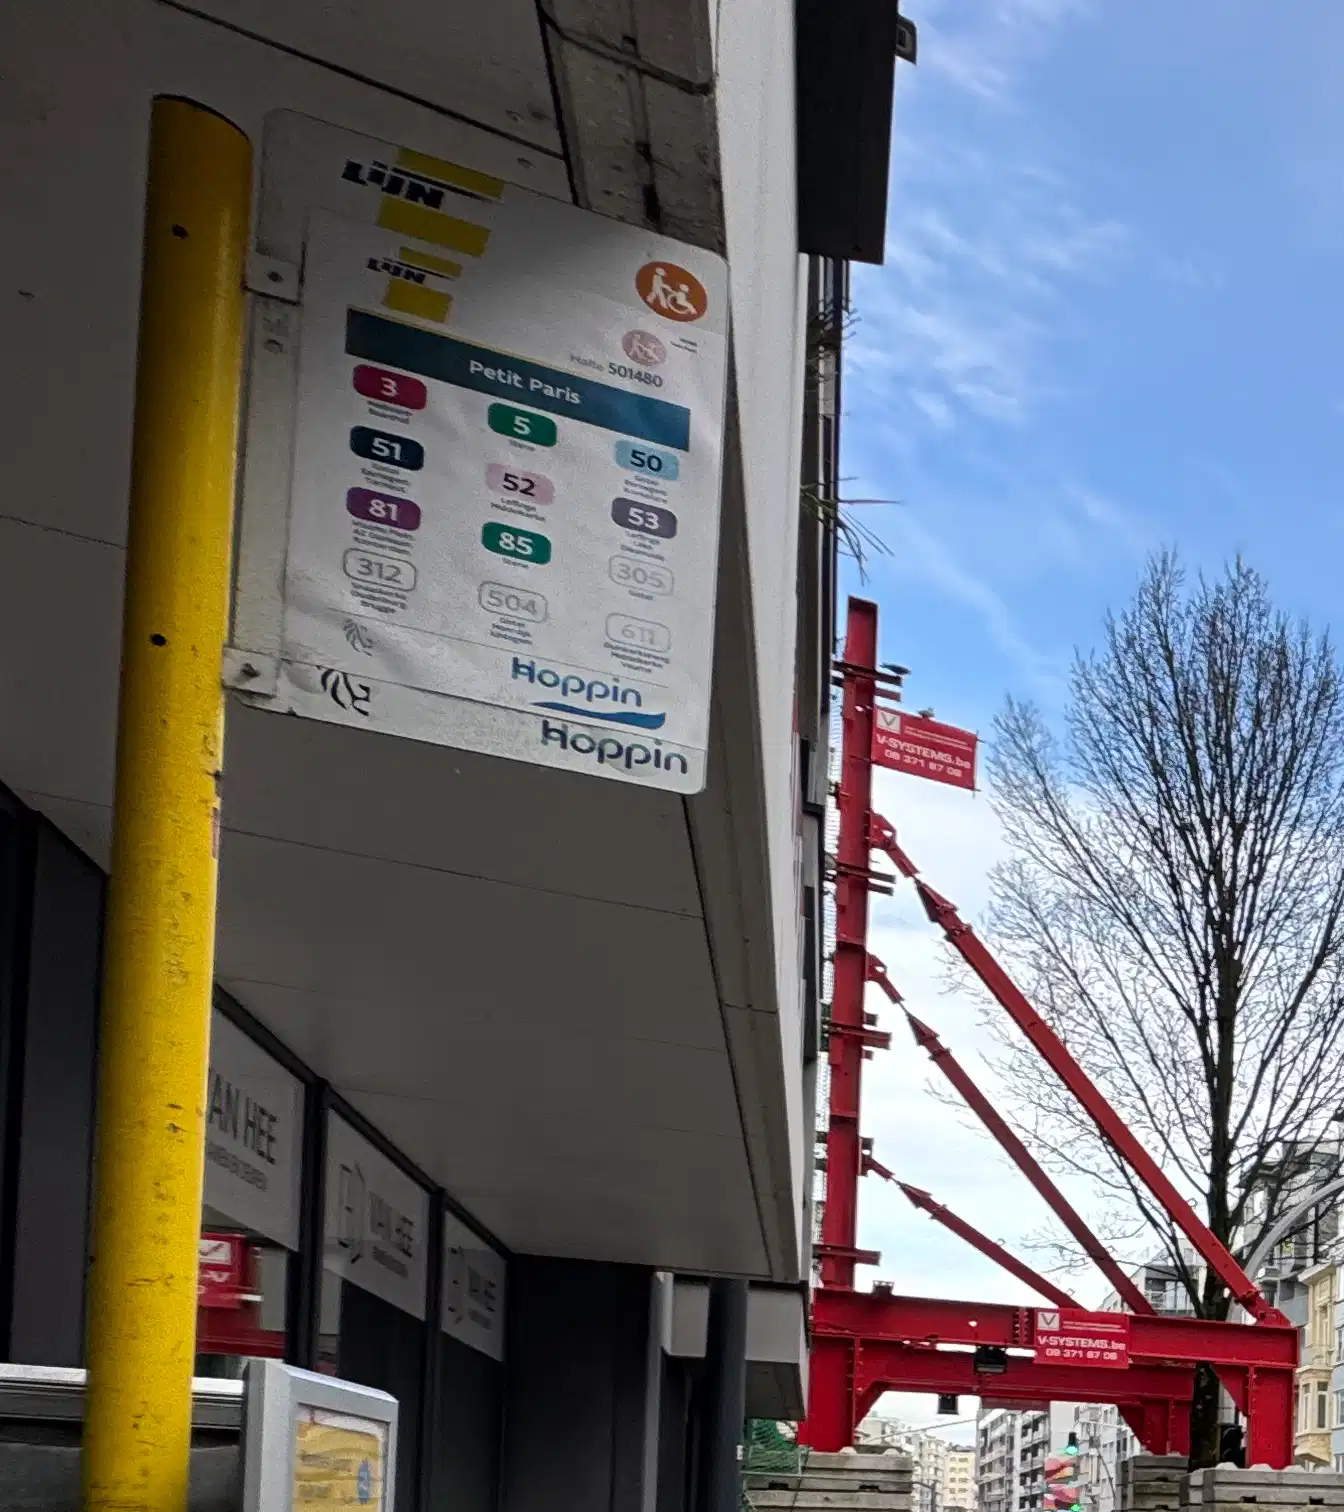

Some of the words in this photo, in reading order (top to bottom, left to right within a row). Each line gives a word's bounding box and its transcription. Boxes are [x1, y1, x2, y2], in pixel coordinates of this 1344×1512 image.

[380, 376, 399, 397] 3
[469, 359, 524, 390] Petit
[529, 377, 581, 404] Paris
[608, 362, 664, 388] 501480
[512, 415, 532, 435] 5
[371, 437, 402, 461] 51
[630, 449, 663, 472] 50
[502, 472, 536, 497] 52
[368, 499, 399, 521] 81
[628, 507, 660, 530] 53
[499, 531, 533, 556] 85
[357, 557, 405, 585] 312
[617, 563, 667, 589] 305
[486, 589, 538, 615] 504
[512, 656, 642, 707] Hoppin
[541, 719, 688, 774] Hoppin
[876, 733, 972, 769] V-SYSTEMS.be
[1037, 1335, 1127, 1350] V-SYSTEMS.be
